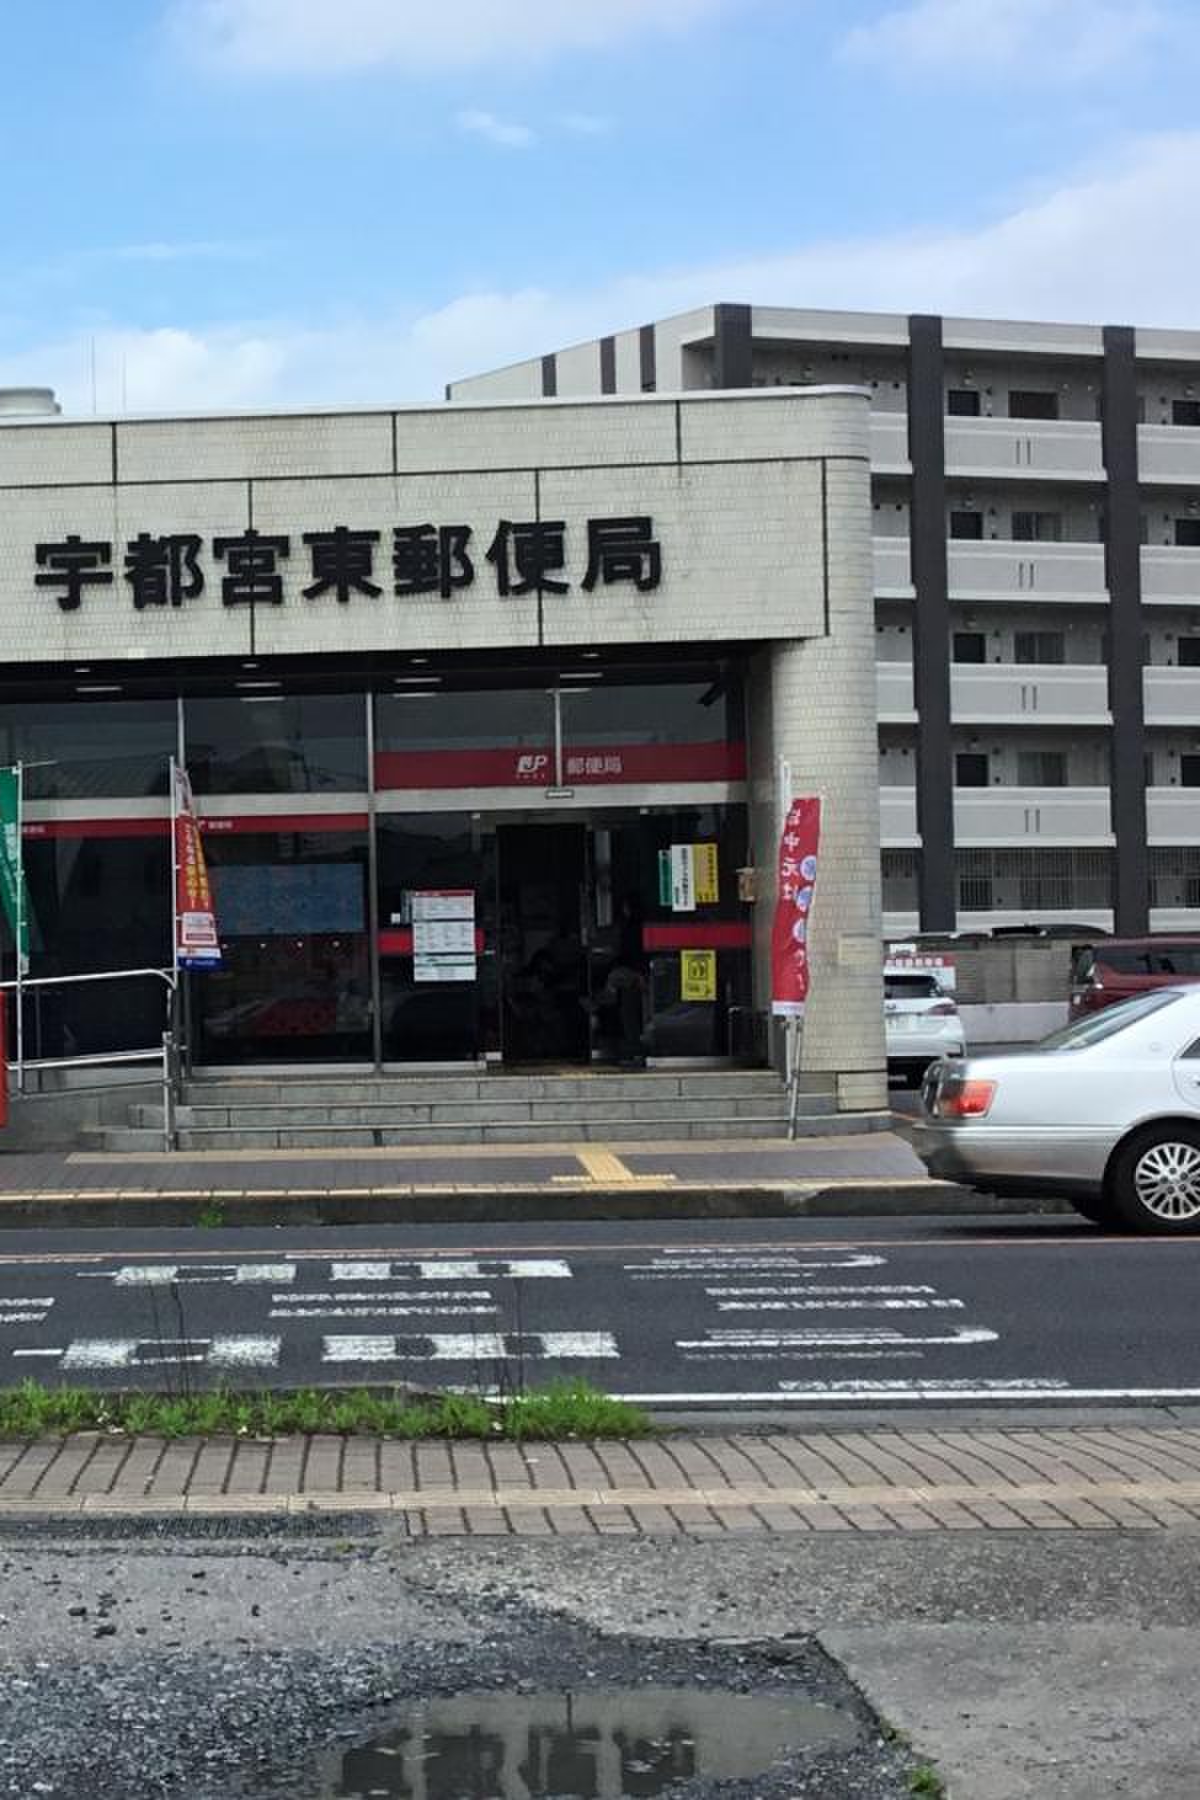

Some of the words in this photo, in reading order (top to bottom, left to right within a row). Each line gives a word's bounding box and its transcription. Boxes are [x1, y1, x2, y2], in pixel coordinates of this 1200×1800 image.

[35, 516, 662, 610] 宇都宮東郵便局
